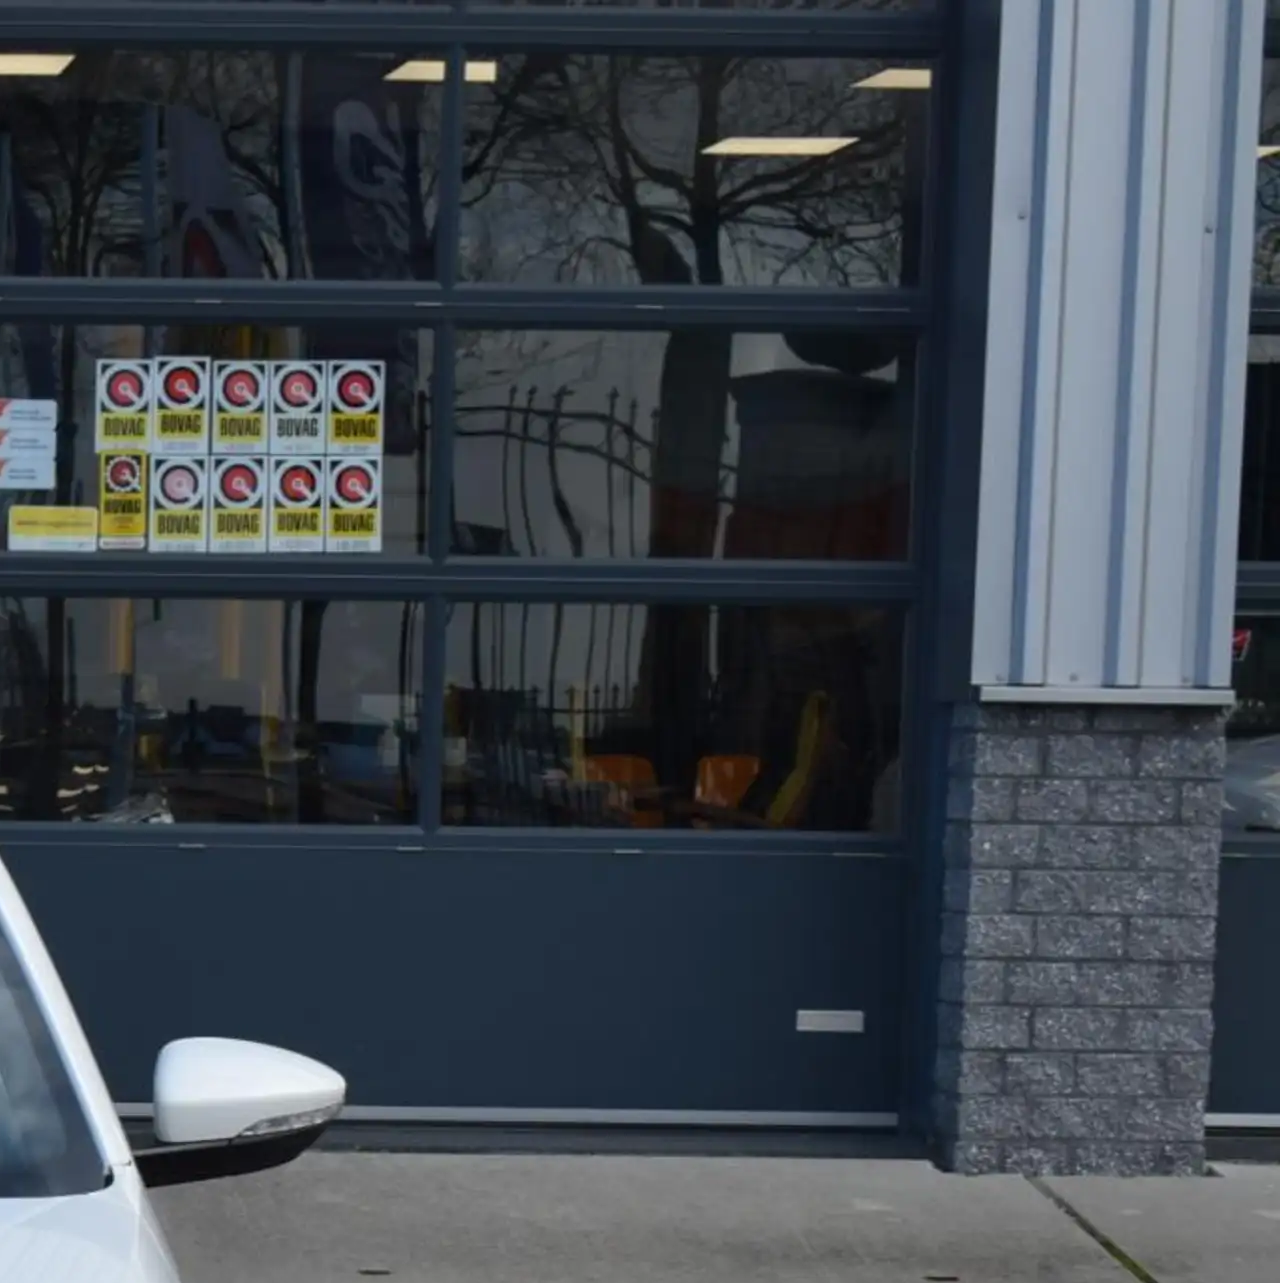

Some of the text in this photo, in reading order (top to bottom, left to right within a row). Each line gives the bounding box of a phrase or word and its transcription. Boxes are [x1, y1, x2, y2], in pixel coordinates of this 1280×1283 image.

[103, 417, 146, 437] BOVAG
[160, 413, 202, 435] BOVAG
[219, 417, 261, 438] BOVAG
[276, 417, 319, 439] BOVAG
[334, 418, 377, 439] BOVAG
[157, 513, 201, 535] BOVAG
[217, 513, 260, 534] BOVAG
[276, 511, 319, 532] BOVAG
[333, 512, 375, 533] BOVAG
